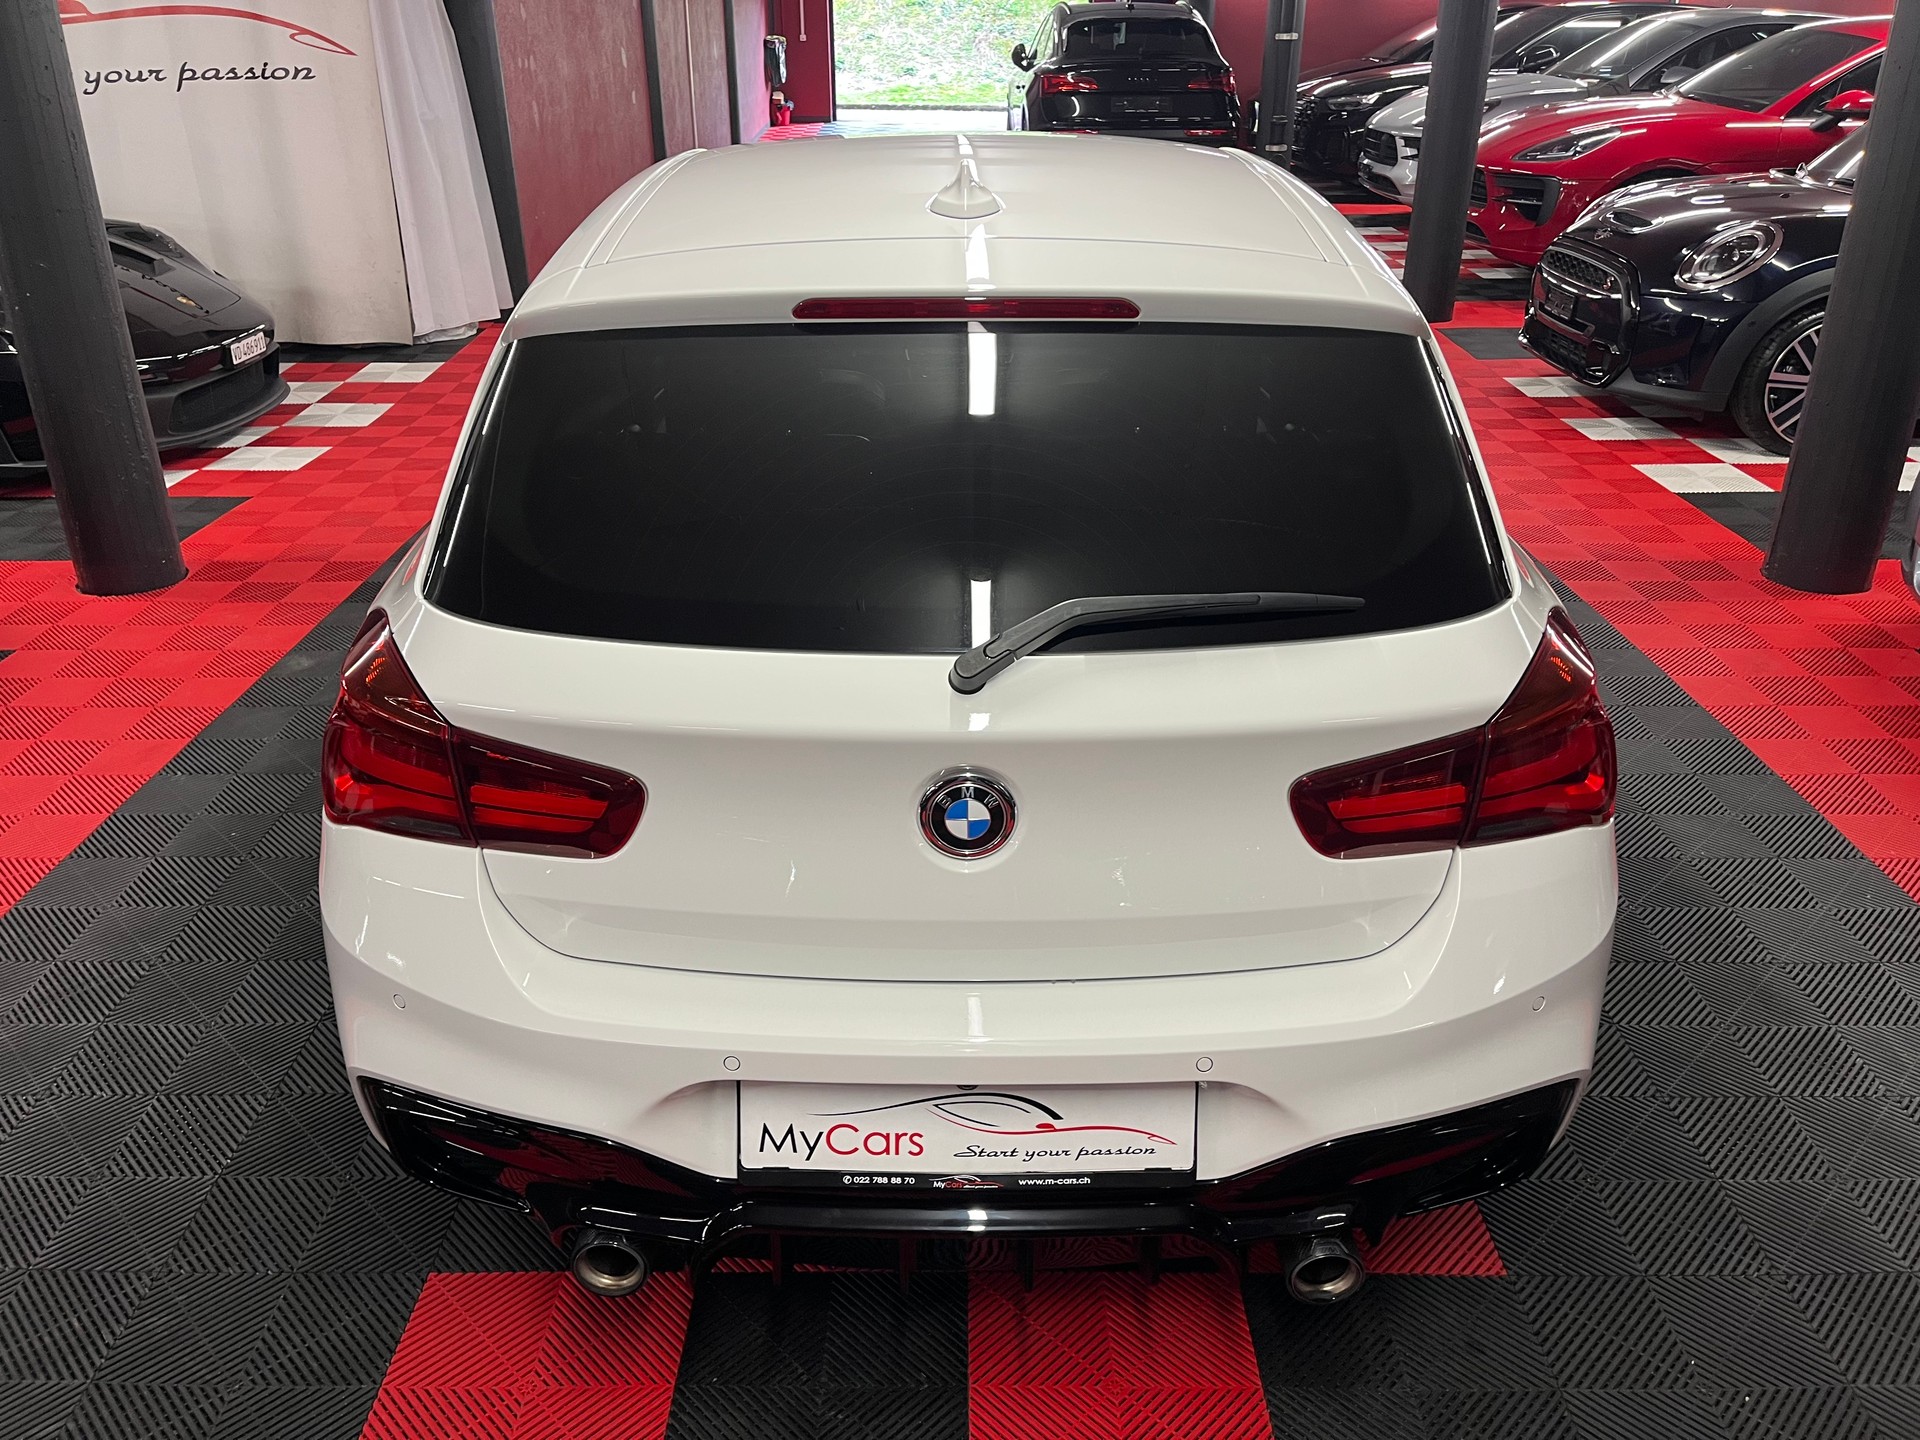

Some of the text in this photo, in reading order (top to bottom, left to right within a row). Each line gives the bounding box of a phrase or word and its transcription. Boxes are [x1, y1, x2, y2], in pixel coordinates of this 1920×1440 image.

[83, 61, 316, 96] your passion
[937, 786, 999, 809] BMW
[758, 1122, 925, 1162] MyCars
[953, 1144, 1157, 1163] Start your passion
[853, 1176, 916, 1185] 022 788 88 70
[933, 1181, 963, 1189] MyCars
[1018, 1177, 1091, 1186] www.m-cars.ch
